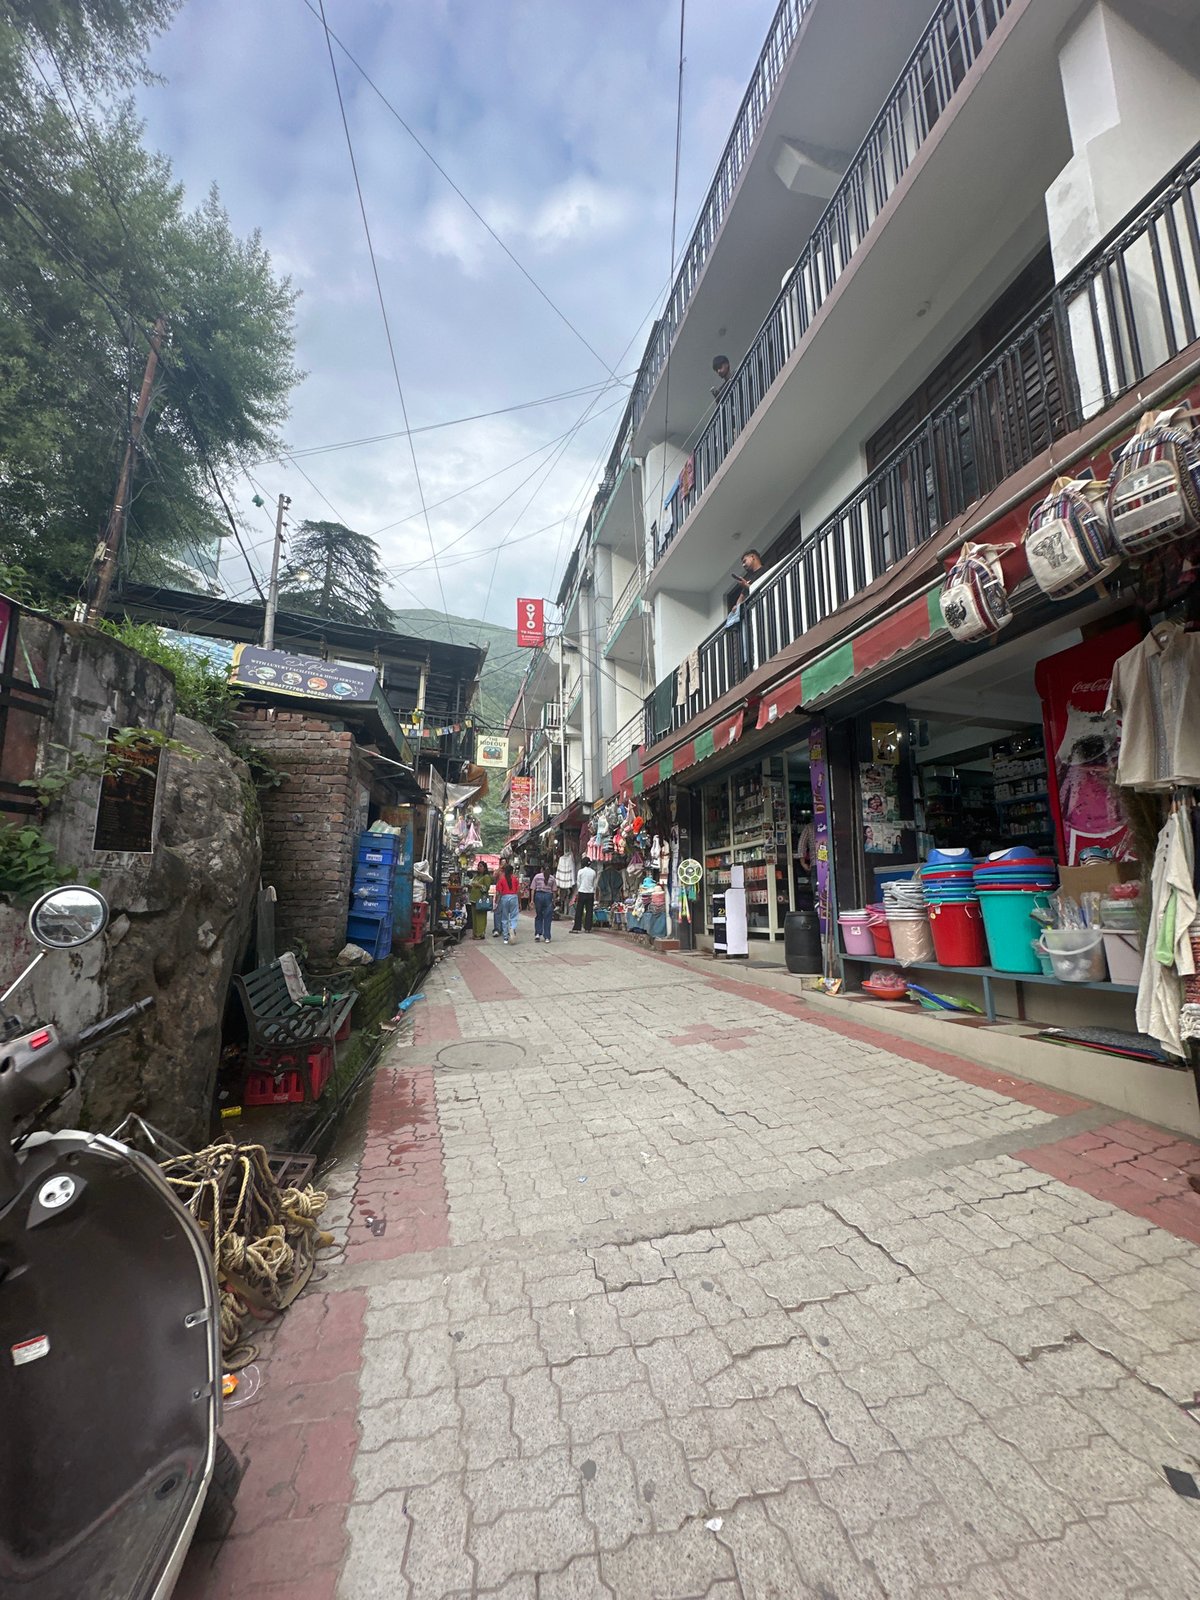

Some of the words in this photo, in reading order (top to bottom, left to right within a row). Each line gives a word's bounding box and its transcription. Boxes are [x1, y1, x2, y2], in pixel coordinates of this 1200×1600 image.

[526, 603, 536, 629] OYO
[266, 661, 289, 671] LUXURY
[289, 667, 319, 676] FACILITIES
[339, 677, 364, 685] SERVICES
[480, 740, 506, 748] HIDEOUT
